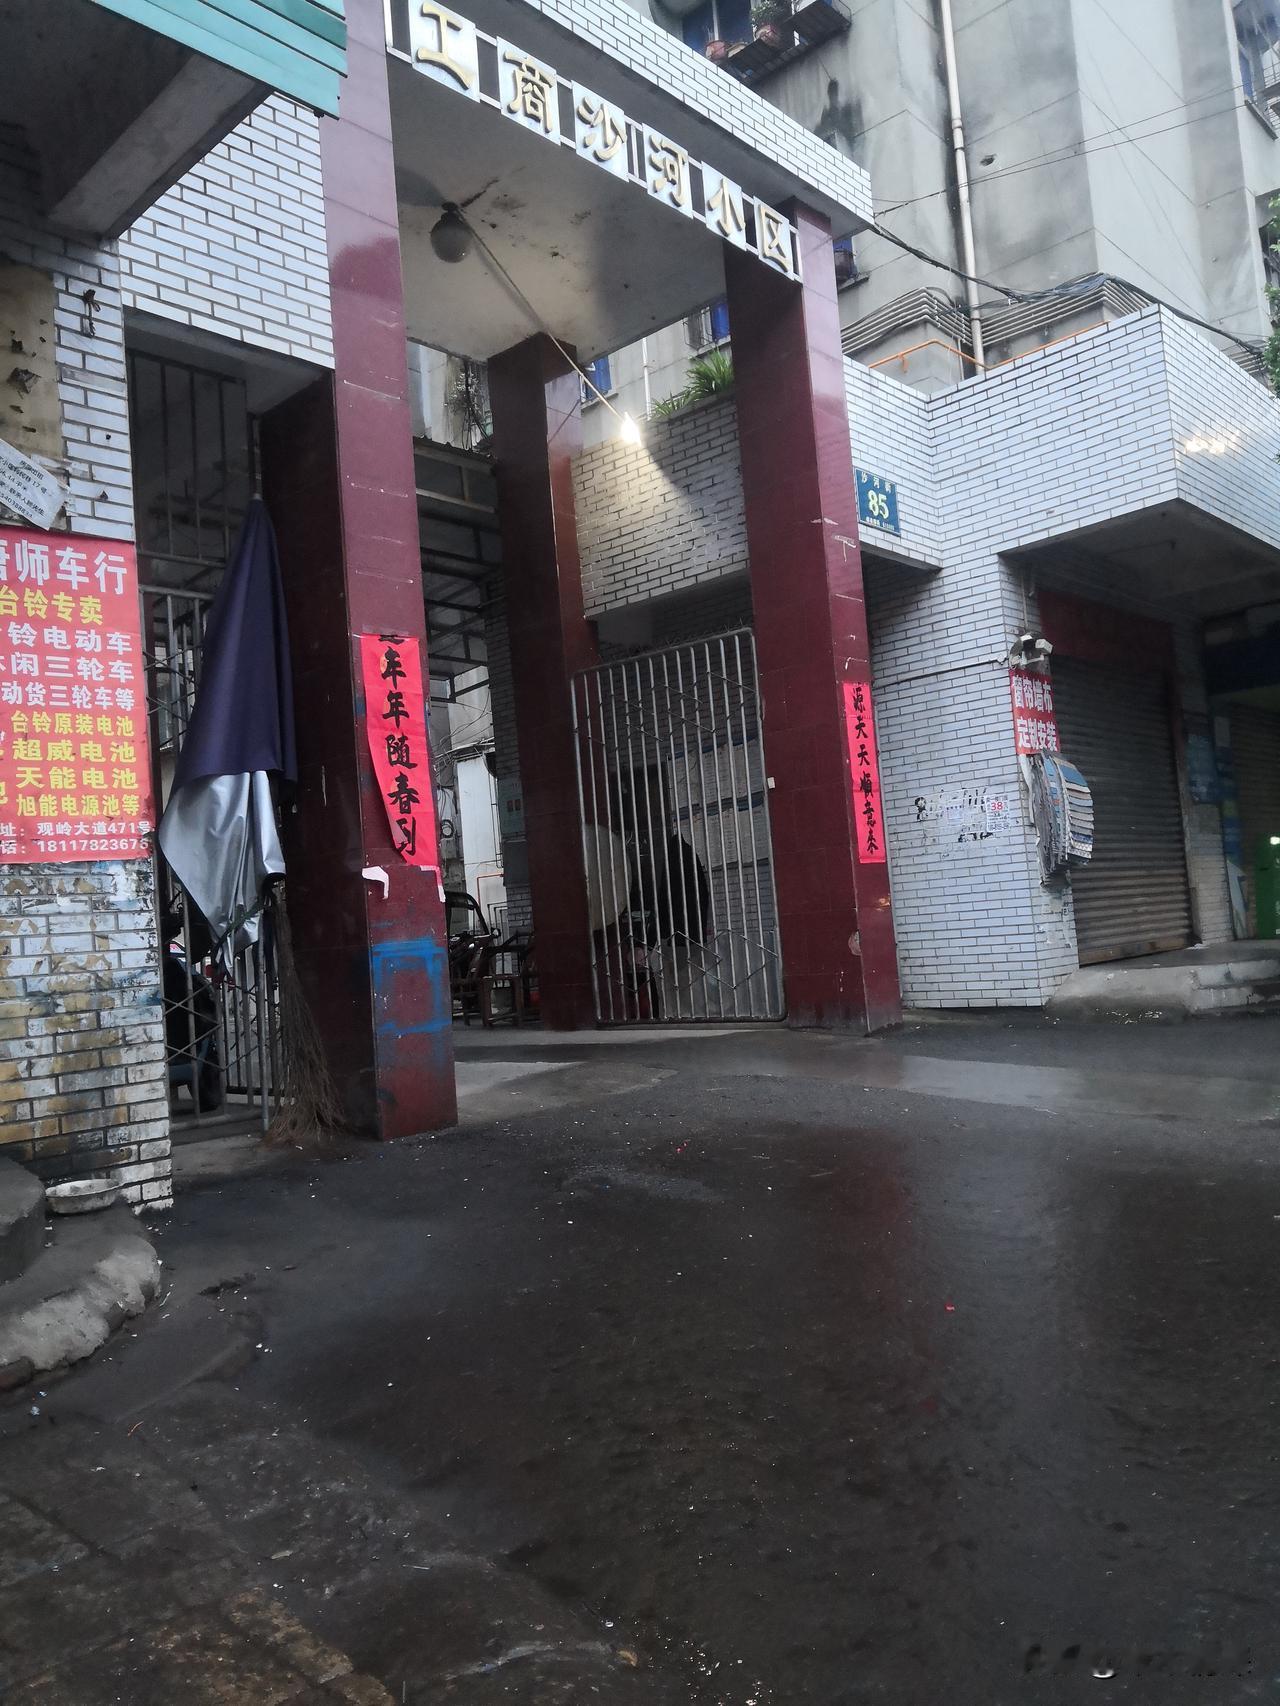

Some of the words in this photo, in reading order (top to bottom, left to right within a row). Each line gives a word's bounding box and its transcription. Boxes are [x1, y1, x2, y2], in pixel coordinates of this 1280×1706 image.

[417, 2, 790, 273] 工商沙河小区
[868, 490, 889, 519] 85
[0, 585, 103, 625] 台铃专卖
[0, 621, 132, 655] 铃电动车
[0, 652, 134, 684] 闲三轮车
[2, 682, 136, 712] 动货三轮车等
[11, 711, 134, 737] 台铃原装电池
[1017, 716, 1058, 752] 定制安装
[13, 739, 137, 763] 超威电池
[16, 767, 138, 790] 天能电池
[16, 794, 140, 817] 旭能电源池等
